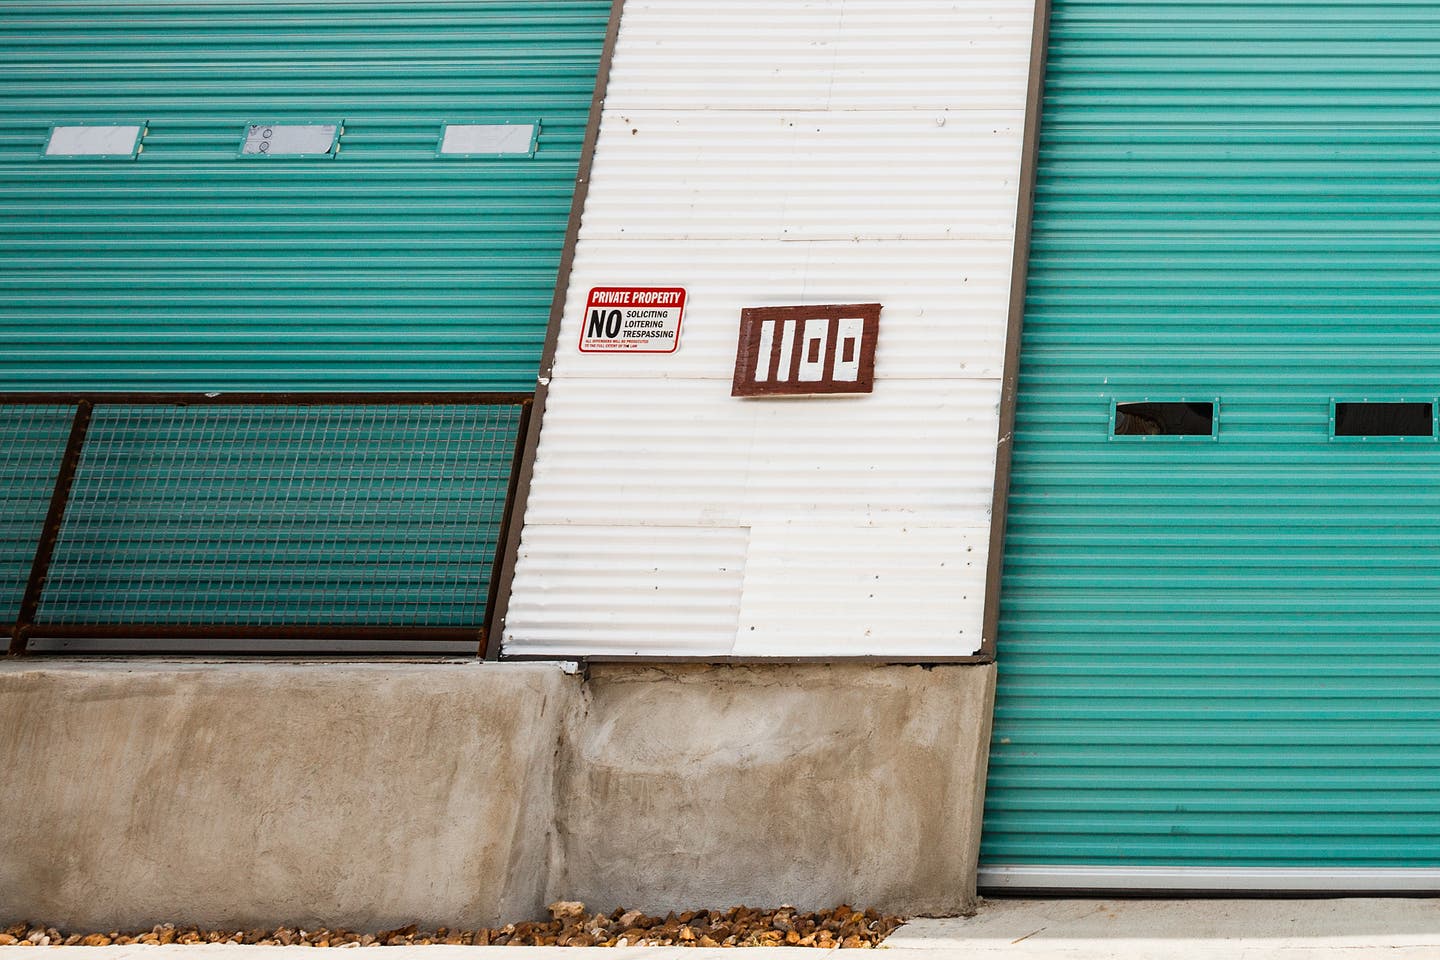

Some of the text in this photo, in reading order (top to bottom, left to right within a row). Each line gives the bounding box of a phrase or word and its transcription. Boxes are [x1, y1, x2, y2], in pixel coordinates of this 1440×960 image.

[592, 291, 681, 304] PRIVATE PROPERTY
[626, 310, 668, 318] SOLICITING
[587, 309, 623, 339] NO
[624, 320, 664, 328] LOITERING
[622, 330, 674, 338] TRESPASSING
[754, 318, 864, 382] 1100
